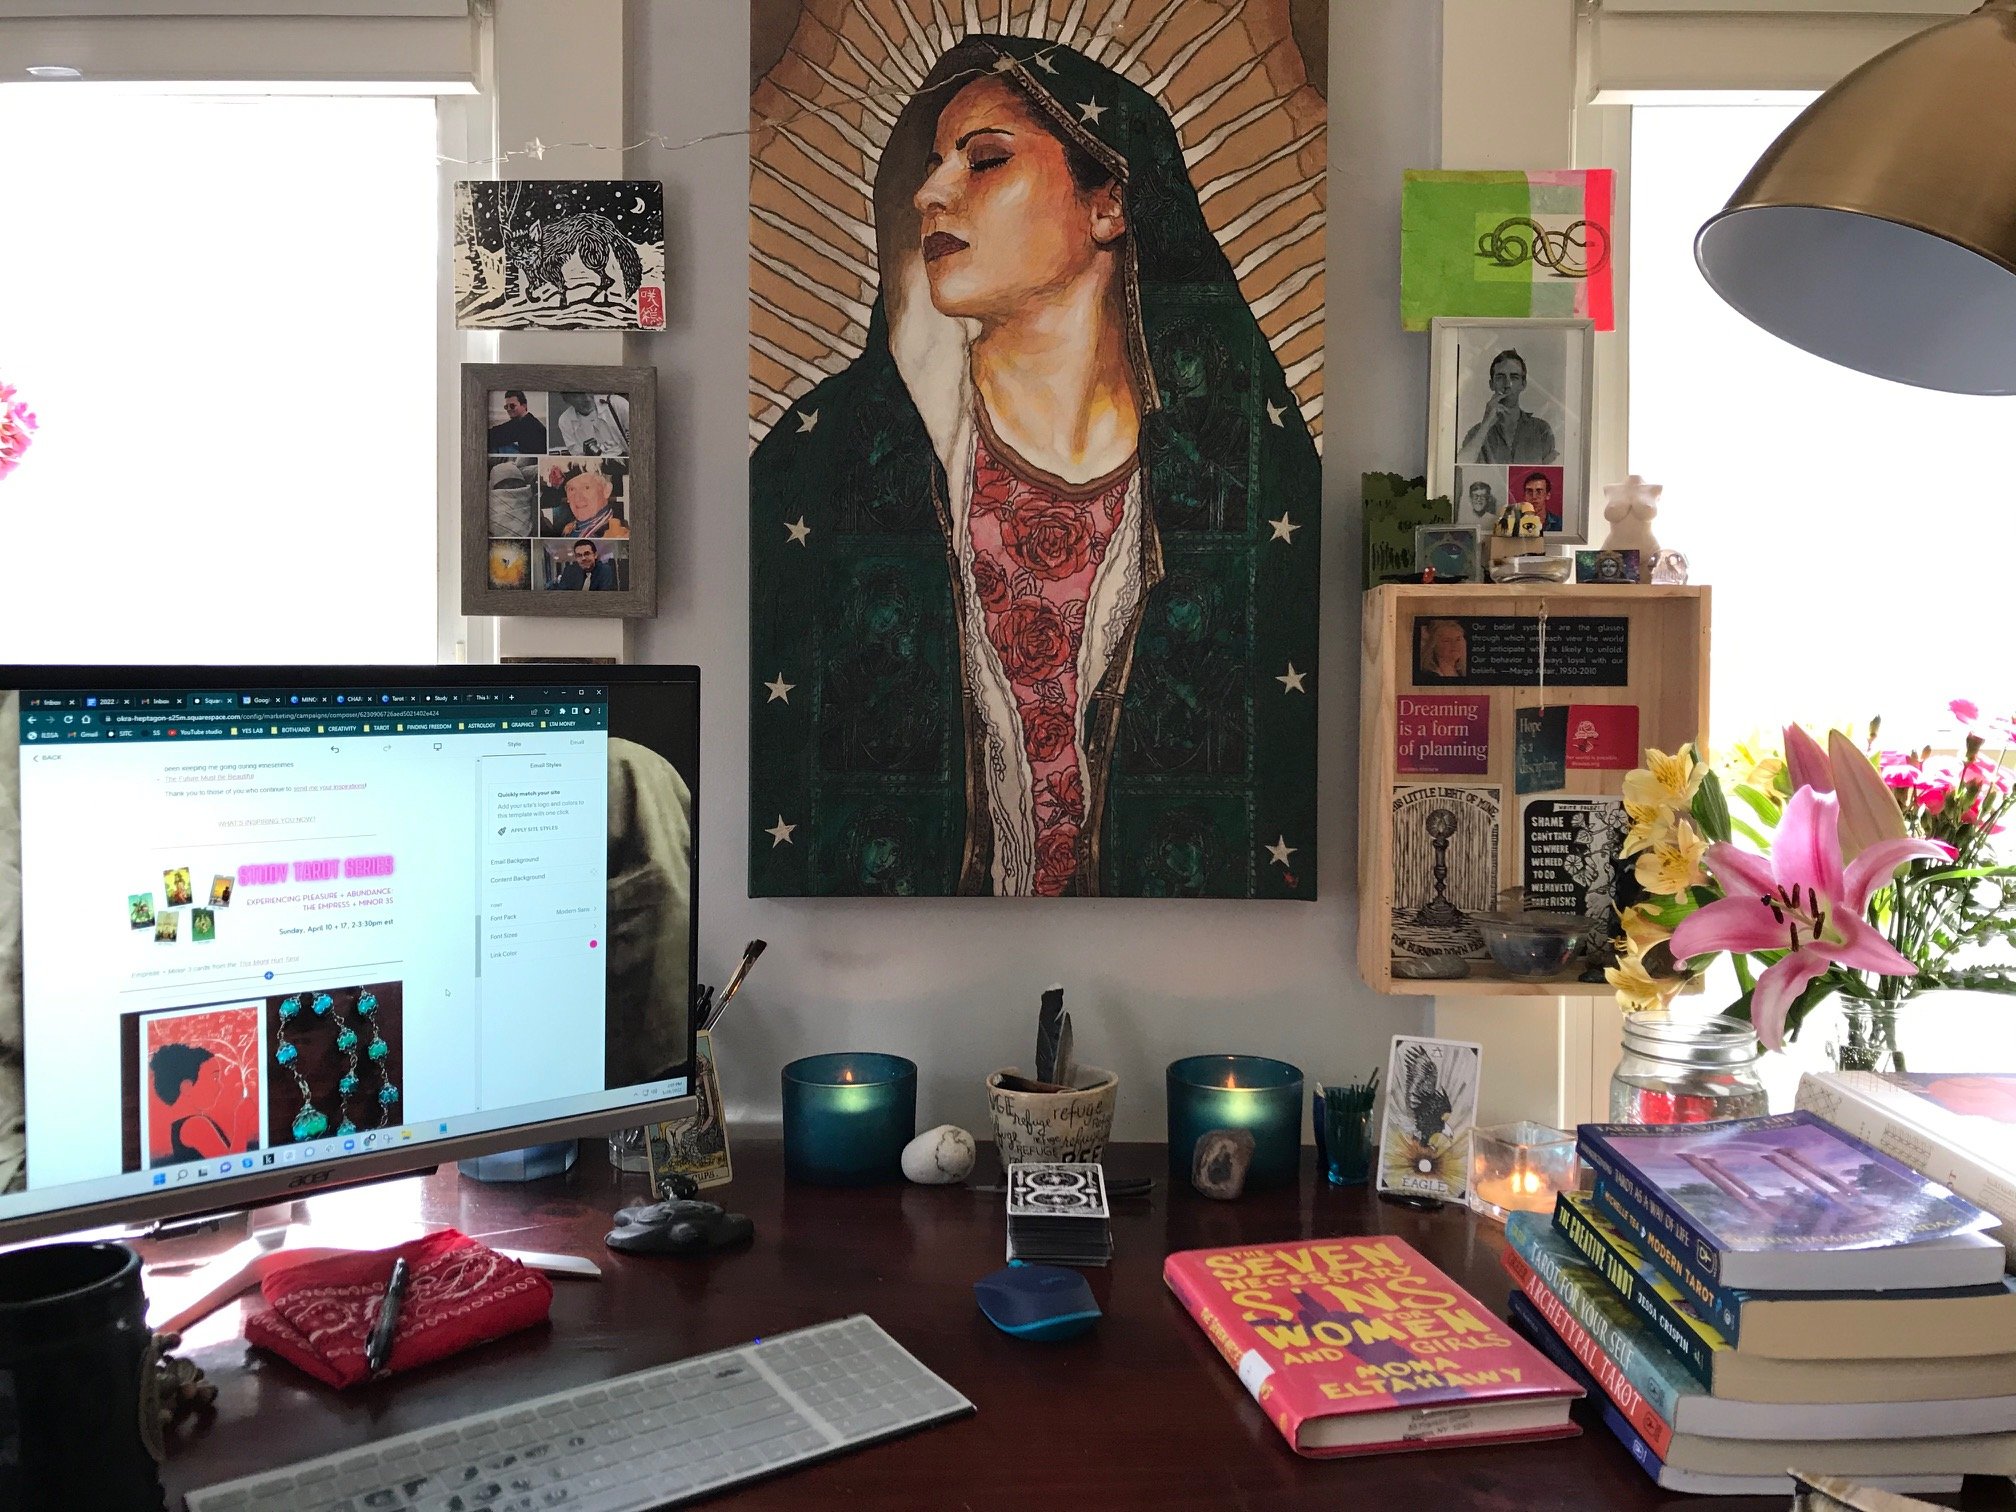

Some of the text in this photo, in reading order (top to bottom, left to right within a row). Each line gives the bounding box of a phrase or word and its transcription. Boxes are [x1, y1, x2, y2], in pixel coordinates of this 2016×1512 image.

[1597, 624, 1625, 633] glasses
[1602, 634, 1625, 642] world
[1561, 645, 1582, 654] likely
[1490, 656, 1522, 664] behavior
[1567, 657, 1587, 665] loyal
[1559, 667, 1598, 675] 1950-2010
[1399, 700, 1479, 720] Dreaming
[1399, 720, 1469, 736] is a form
[1520, 718, 1542, 737] Hope
[1399, 740, 1415, 756] of
[219, 763, 237, 771] going
[537, 790, 550, 798] your
[537, 801, 550, 809] logo
[1402, 787, 1499, 818] LITTLE LIGHT OF MINE
[508, 811, 532, 819] template
[1531, 816, 1564, 828] SHAME
[1531, 831, 1572, 842] CAN'T TAKE
[1531, 844, 1570, 854] US WHERE
[506, 856, 539, 866] Background
[1531, 857, 1563, 867] WE NEED
[238, 855, 394, 887] STUDY TAROT SERIES
[1533, 870, 1543, 879] TO
[490, 873, 546, 884] Content Background
[1531, 883, 1574, 892] WE HAVE TO
[246, 892, 338, 907] EXPERIENCING PLEASURE
[303, 898, 384, 912] THE EMPRESS MINOR
[1550, 897, 1577, 907] RISKS
[490, 913, 517, 922] Font Pack
[555, 907, 577, 915] Modern
[279, 918, 394, 936] Sunday, April 10 est
[490, 933, 503, 941] Font
[502, 950, 518, 958] Color
[1012, 1108, 1051, 1136] refuge
[288, 1168, 337, 1188] acer
[1402, 1178, 1448, 1193] EAGLE
[1614, 1169, 1634, 1196] TAROT
[1634, 1186, 1643, 1204] AS
[1649, 1202, 1665, 1223] WAY
[1665, 1213, 1675, 1234] OF
[1674, 1223, 1691, 1248] LIFE
[1204, 1243, 1408, 1279] SEVEN
[1231, 1250, 1266, 1259] THE
[1646, 1231, 1684, 1278] MODERN
[1684, 1268, 1716, 1309] TAROT
[1219, 1264, 1413, 1292] NECESSARY
[1558, 1206, 1690, 1355] THE CREATIVE TAROT JESSA CRISPIN
[1531, 1241, 1636, 1370] TAROT FOR YOUR SELF
[1381, 1308, 1431, 1322] FOR
[1254, 1307, 1492, 1350] WOMEN
[1284, 1332, 1512, 1366] AND GIRLS
[1526, 1274, 1598, 1370] ARCHETYPAL
[1597, 1355, 1643, 1417] TAROT
[1355, 1356, 1462, 1379] MONA
[1319, 1367, 1522, 1400] ELTAHAWY
